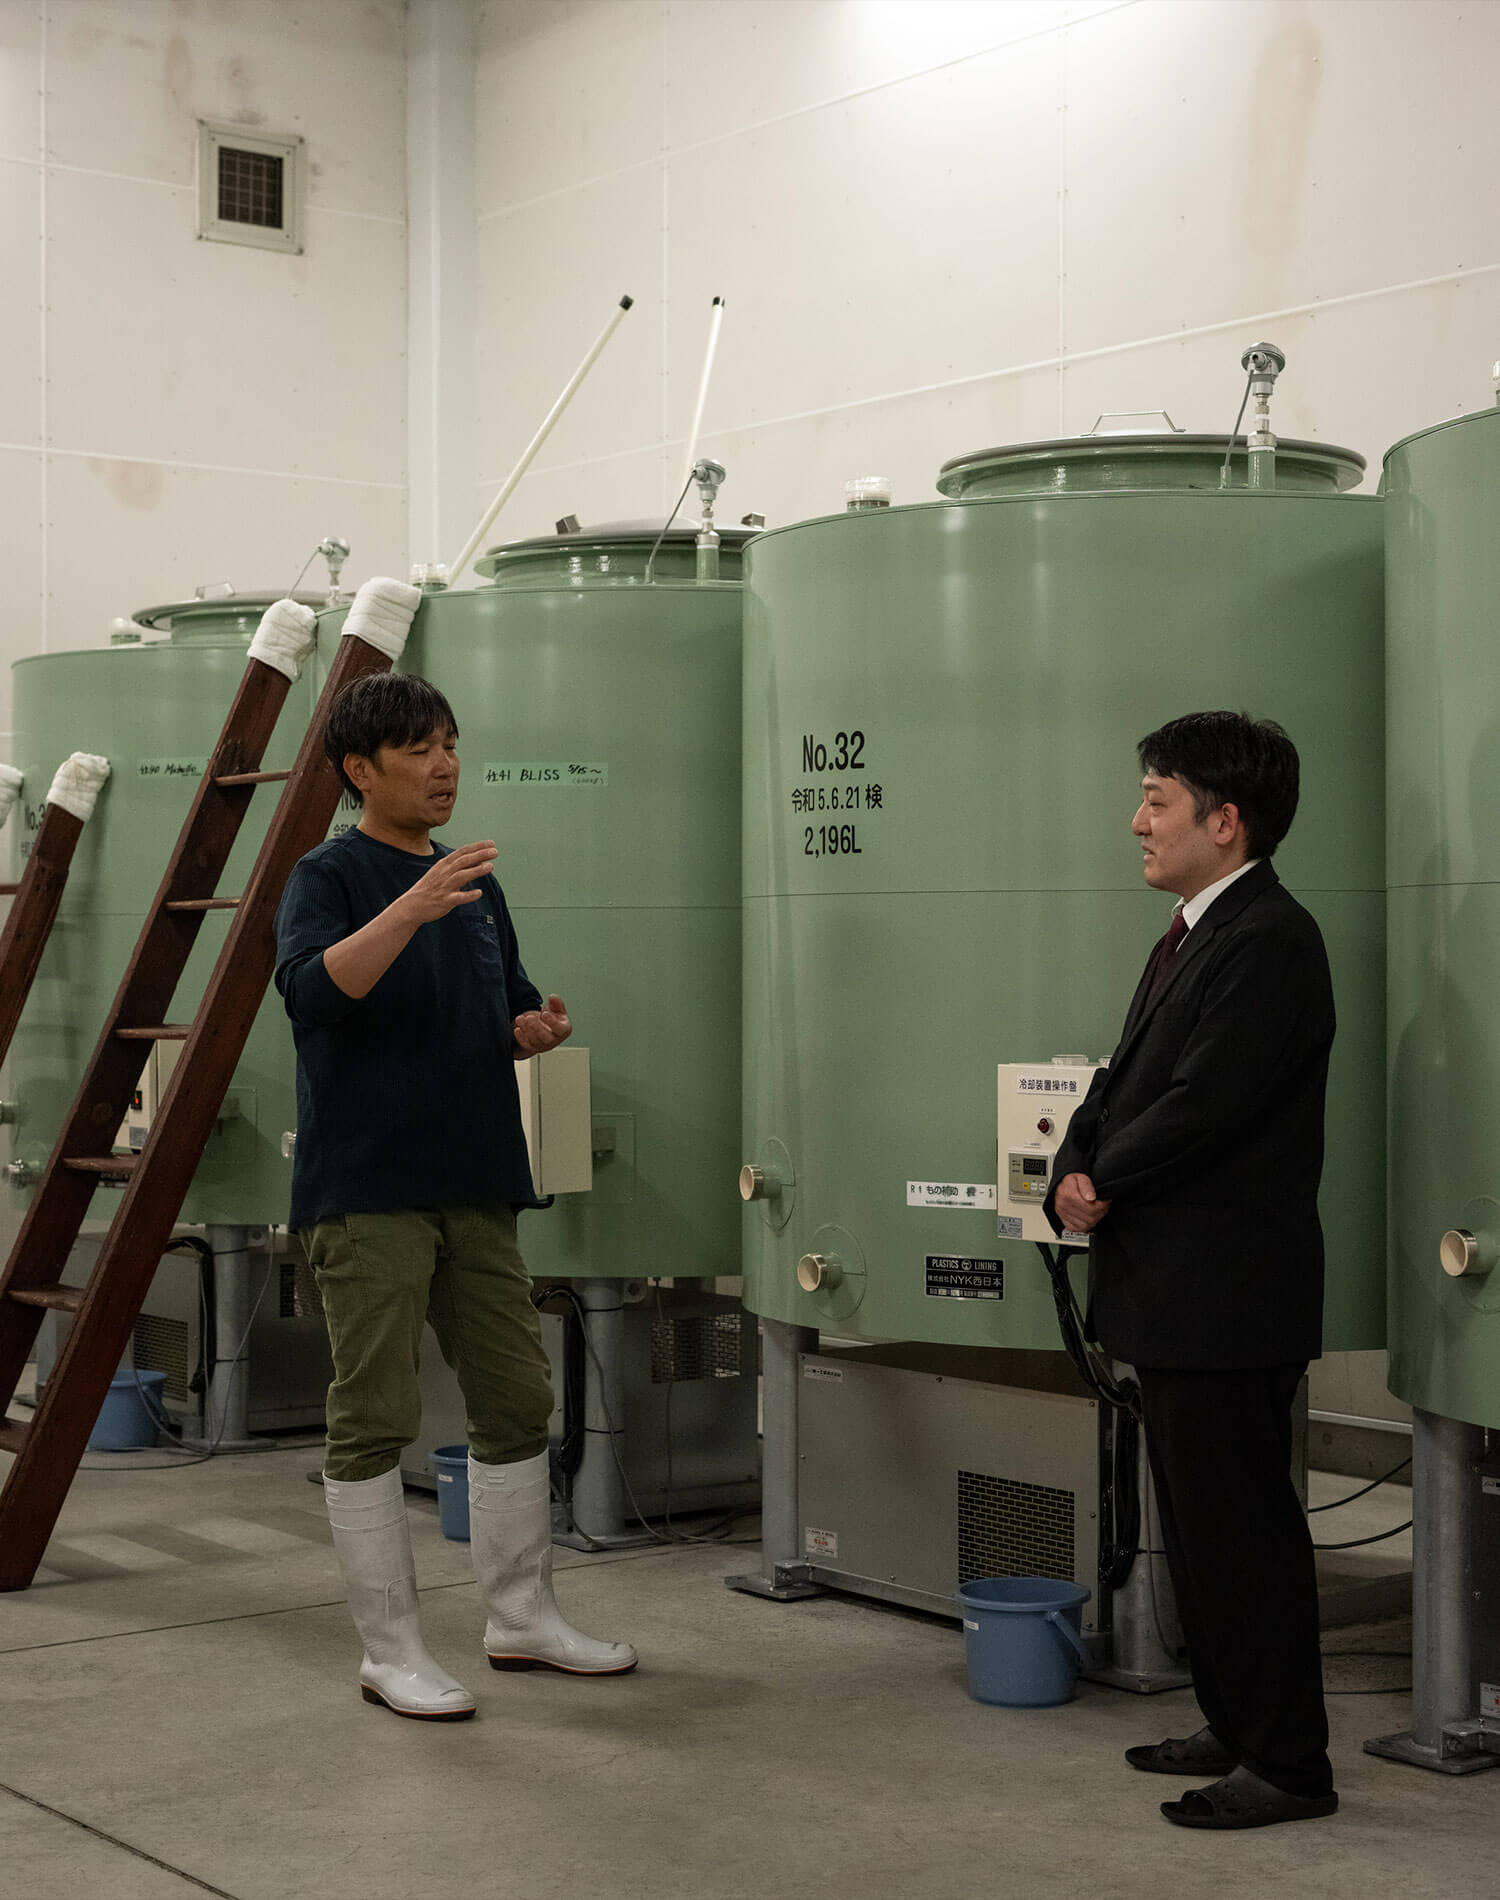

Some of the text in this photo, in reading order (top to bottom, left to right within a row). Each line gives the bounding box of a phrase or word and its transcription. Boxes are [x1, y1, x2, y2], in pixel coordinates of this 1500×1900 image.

[803, 731, 865, 772] No.32
[520, 769, 560, 781] BLISS
[804, 825, 862, 858] 2,196L
[1019, 1078, 1077, 1092] 冷却装置操作盤
[932, 1259, 997, 1271] PLASTICS LINING
